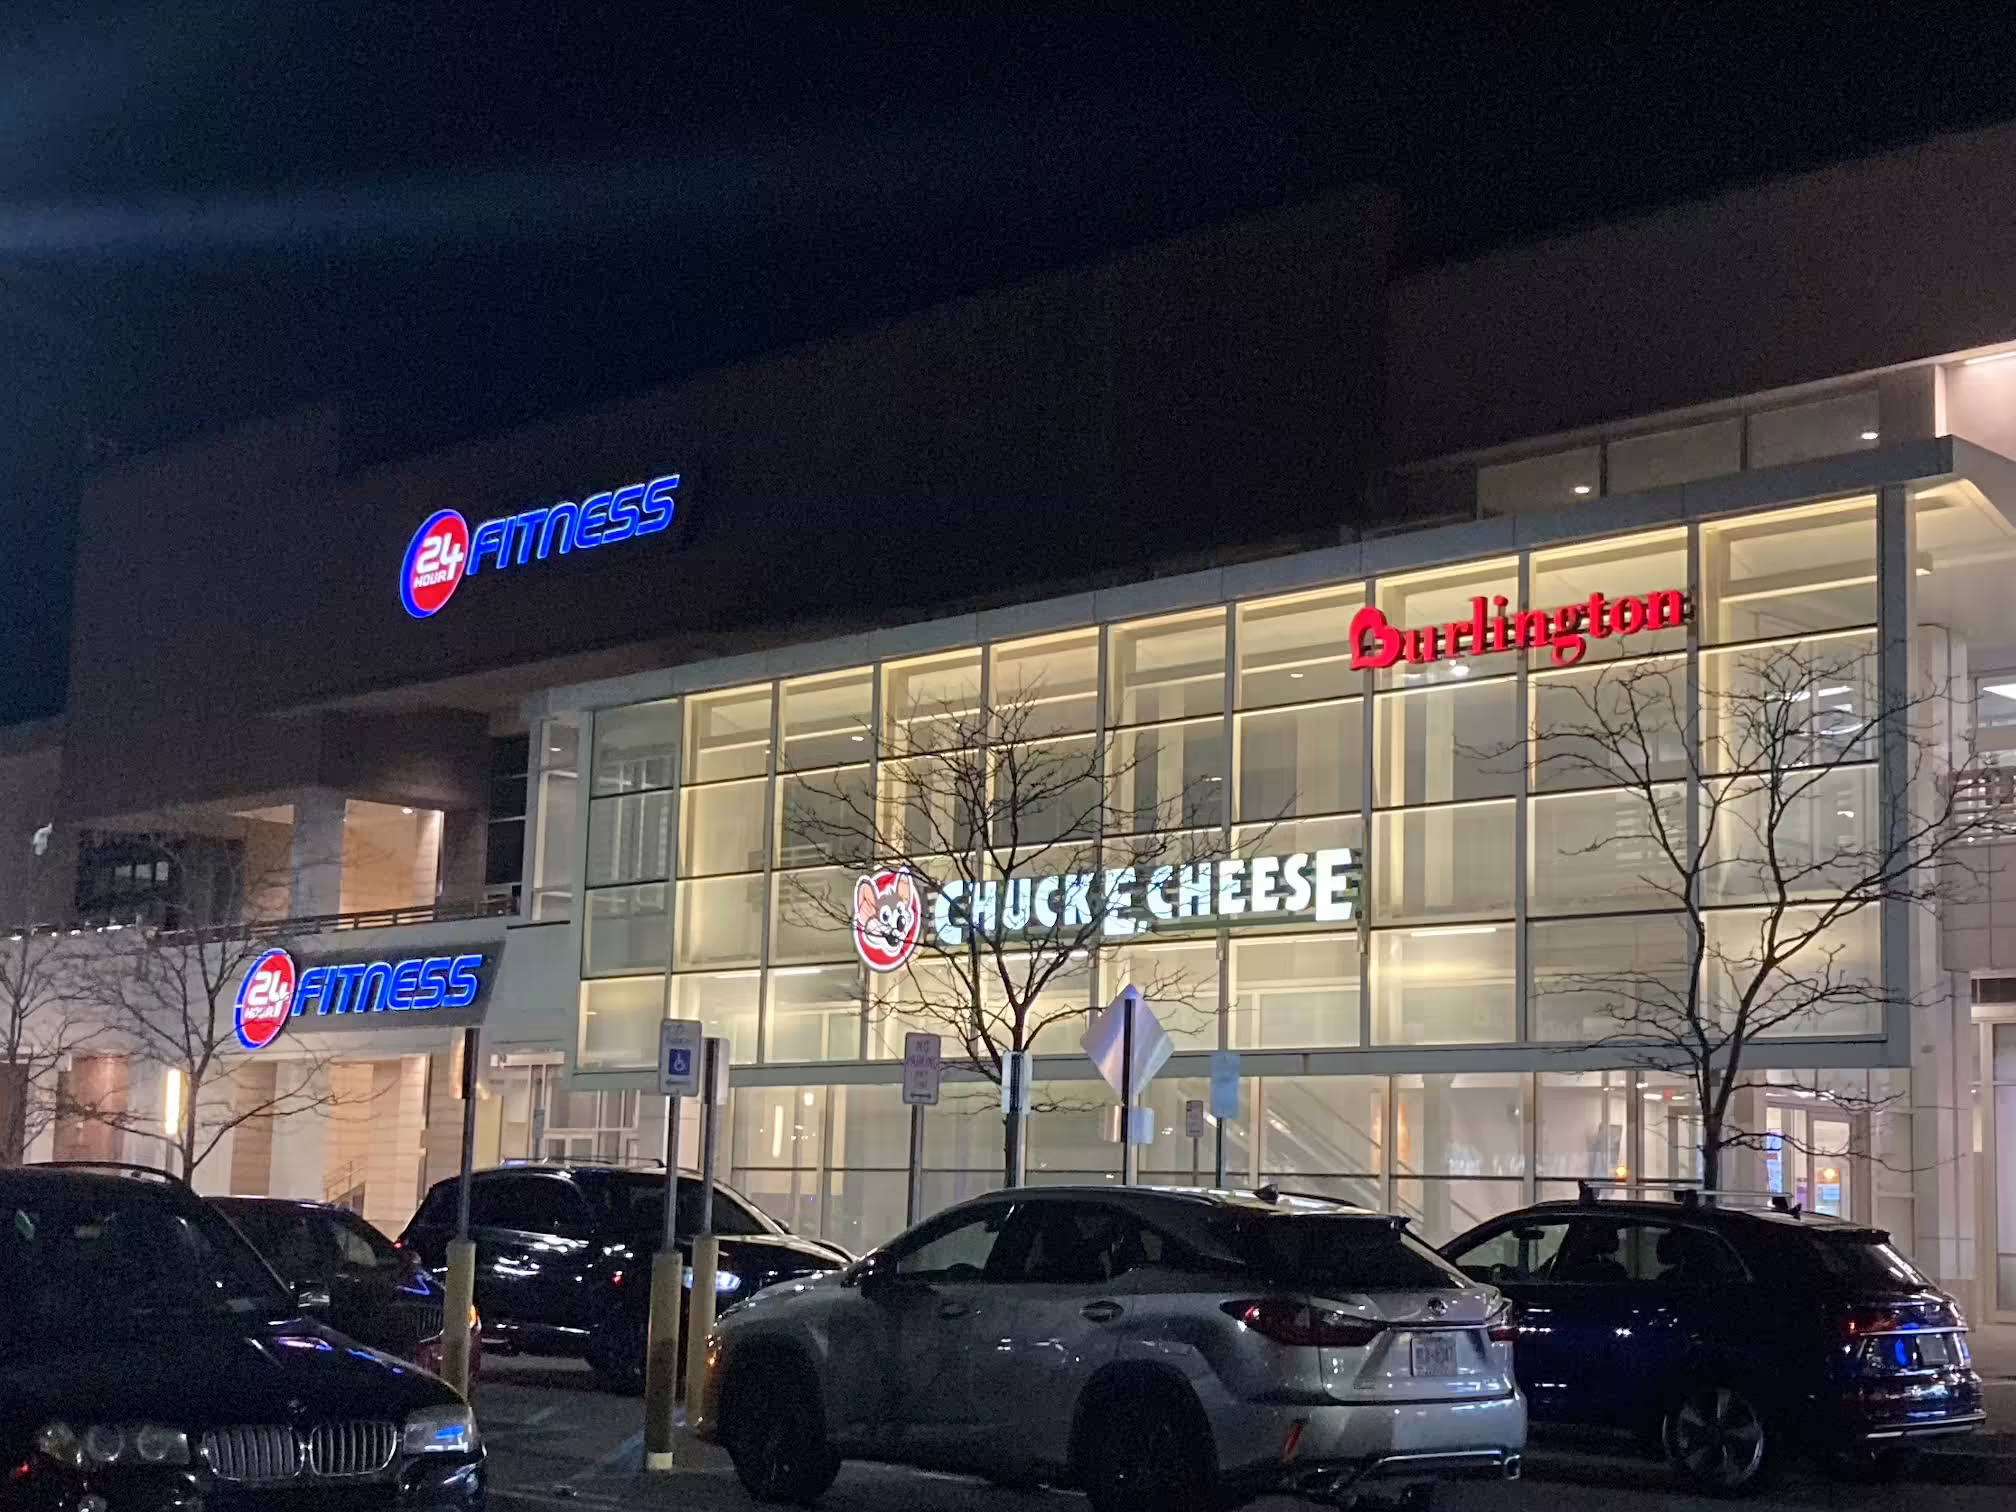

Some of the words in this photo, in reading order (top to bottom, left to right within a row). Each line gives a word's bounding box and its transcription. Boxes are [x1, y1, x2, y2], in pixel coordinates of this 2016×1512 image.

[466, 474, 680, 575] FITNESS
[414, 569, 447, 589] HOUR
[416, 532, 464, 581] 24
[1349, 588, 1687, 672] Burlington
[935, 872, 1096, 945] CHUCK
[1104, 866, 1147, 936] E.
[1147, 847, 1353, 922] CHEESE
[248, 970, 291, 1017] 24
[291, 954, 482, 1017] FITNESS
